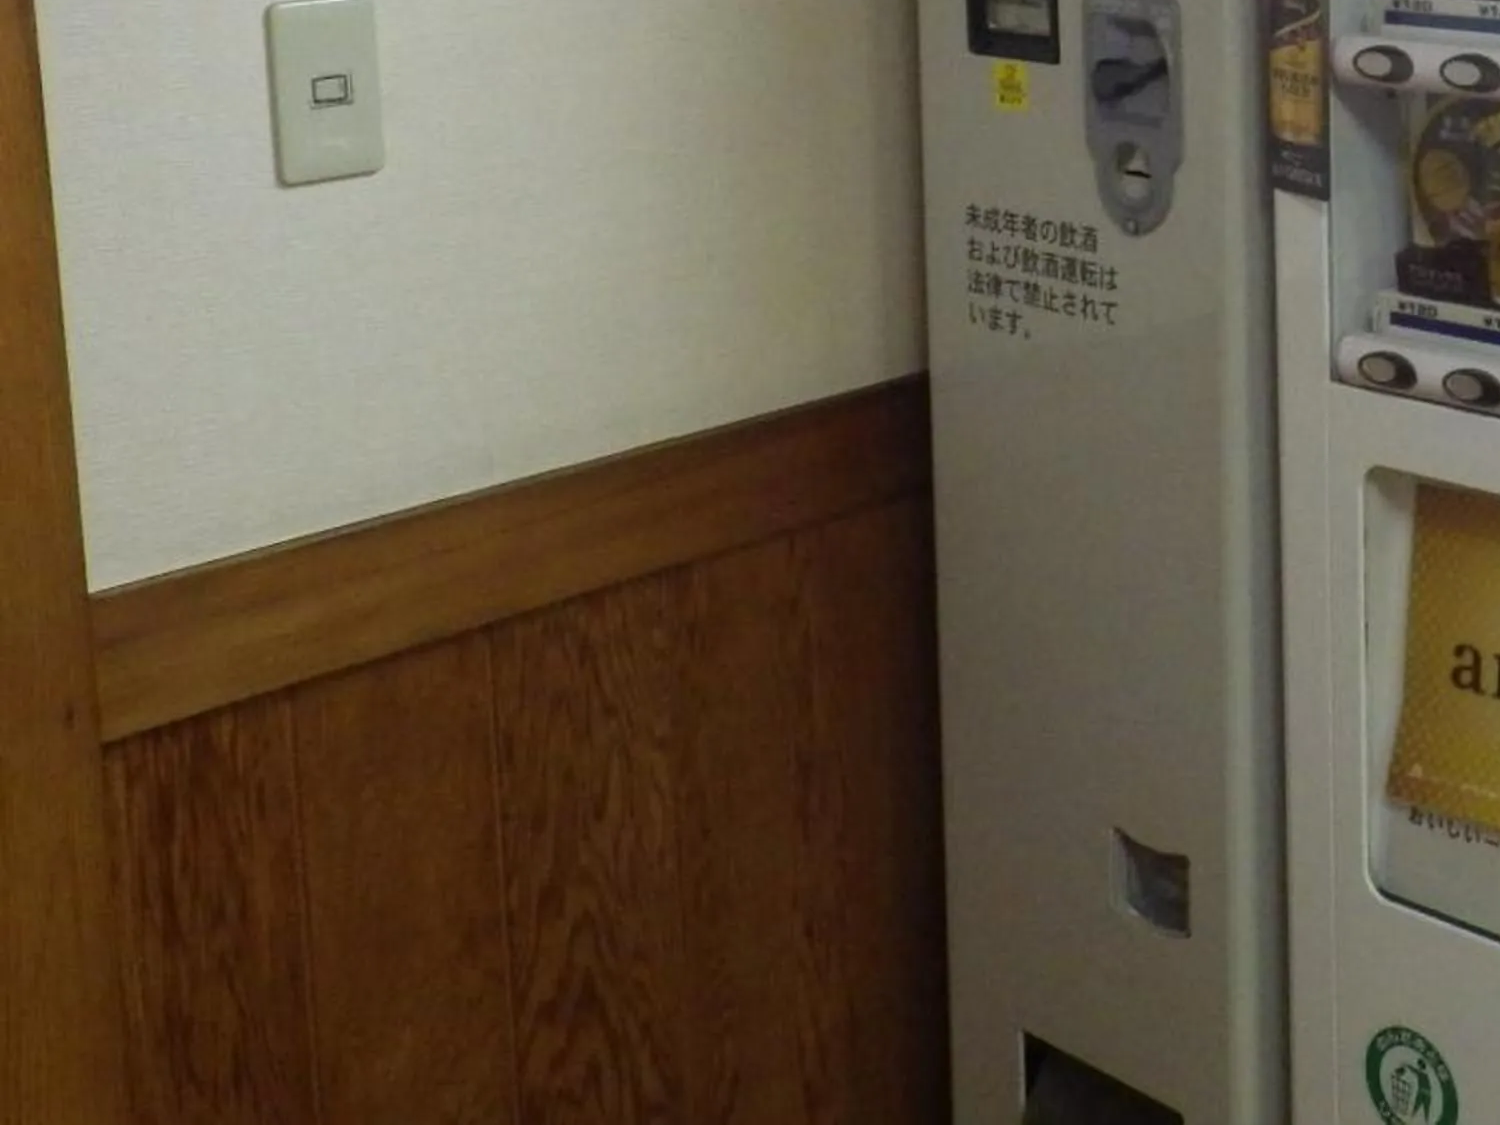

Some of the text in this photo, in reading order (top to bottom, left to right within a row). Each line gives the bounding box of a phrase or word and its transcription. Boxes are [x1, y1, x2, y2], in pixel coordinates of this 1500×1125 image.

[965, 203, 1098, 253] 未成年者の飲酒
[967, 236, 1119, 291] および飲酒運転は
[967, 270, 1119, 326] 法律で禁止されて
[968, 301, 1031, 340] います。
